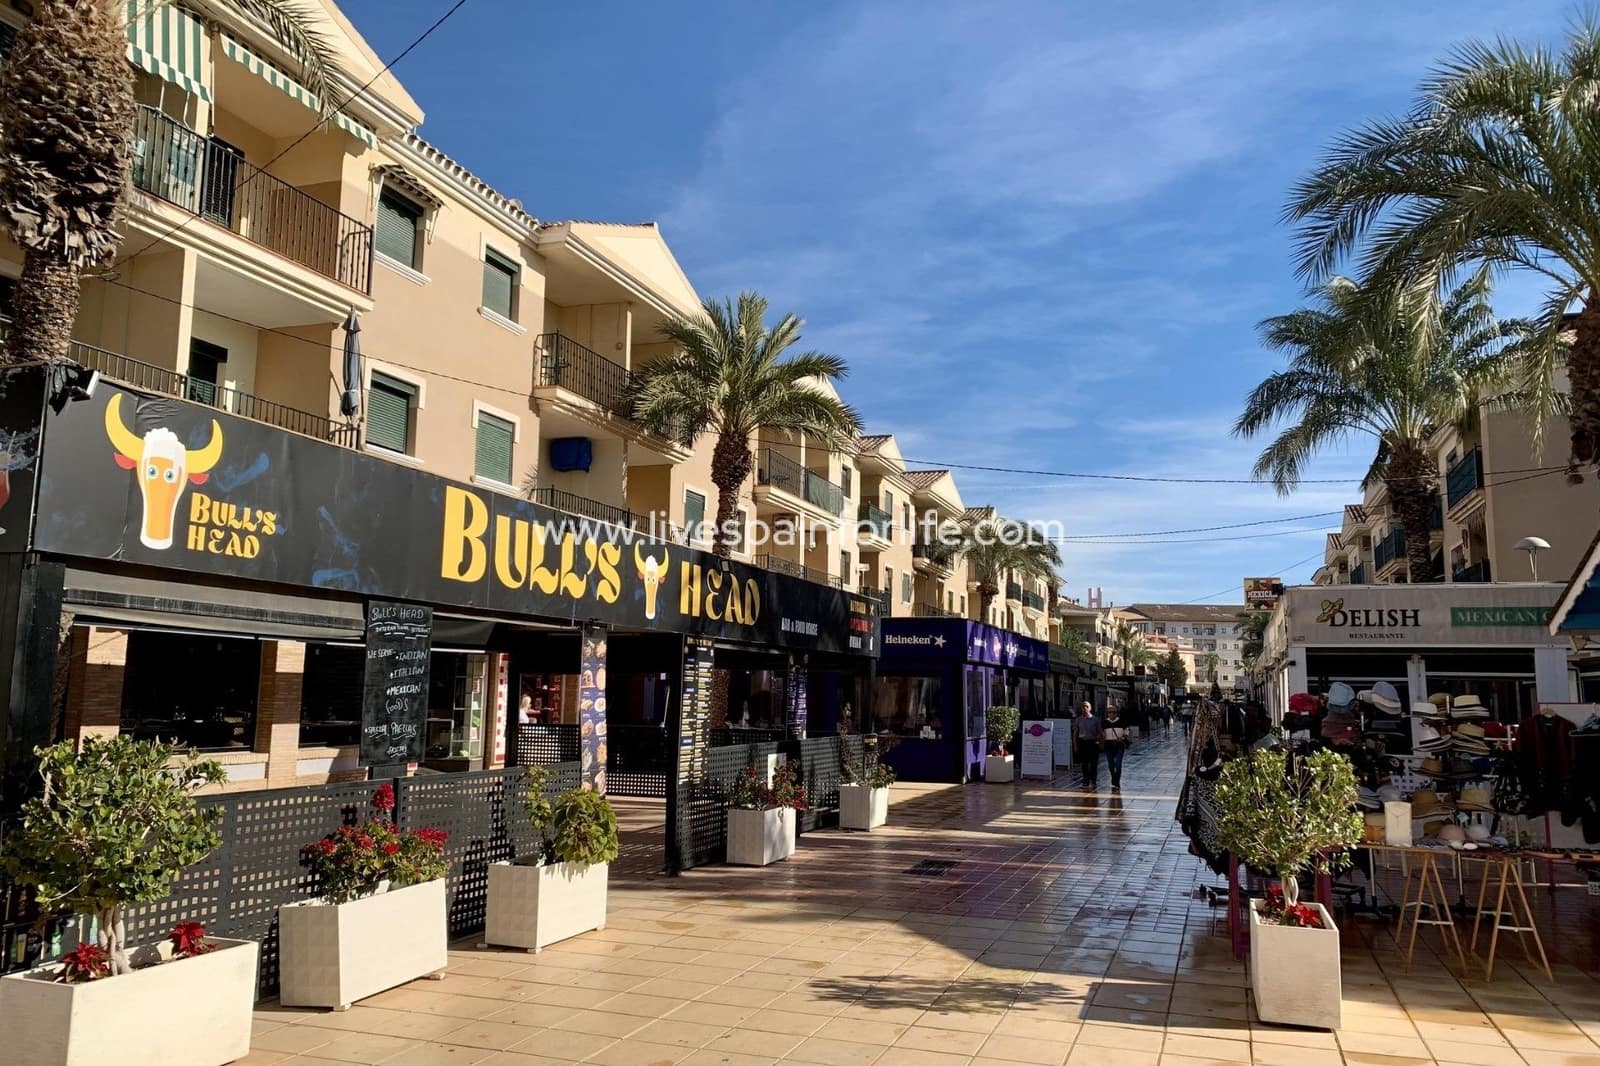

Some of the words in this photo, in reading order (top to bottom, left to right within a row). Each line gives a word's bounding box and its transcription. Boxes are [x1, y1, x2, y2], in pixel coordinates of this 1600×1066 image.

[190, 492, 278, 535] BULL'S
[187, 525, 261, 560] HEAD
[441, 485, 621, 604] BULL'S
[680, 560, 761, 626] HEAD
[400, 608, 424, 619] HEAD
[1329, 608, 1421, 627] DELISH
[1456, 611, 1538, 623] MEXICAN
[885, 634, 931, 645] Heineken
[1349, 632, 1406, 640] RESTAURANTE
[390, 682, 421, 696] MEXICAN
